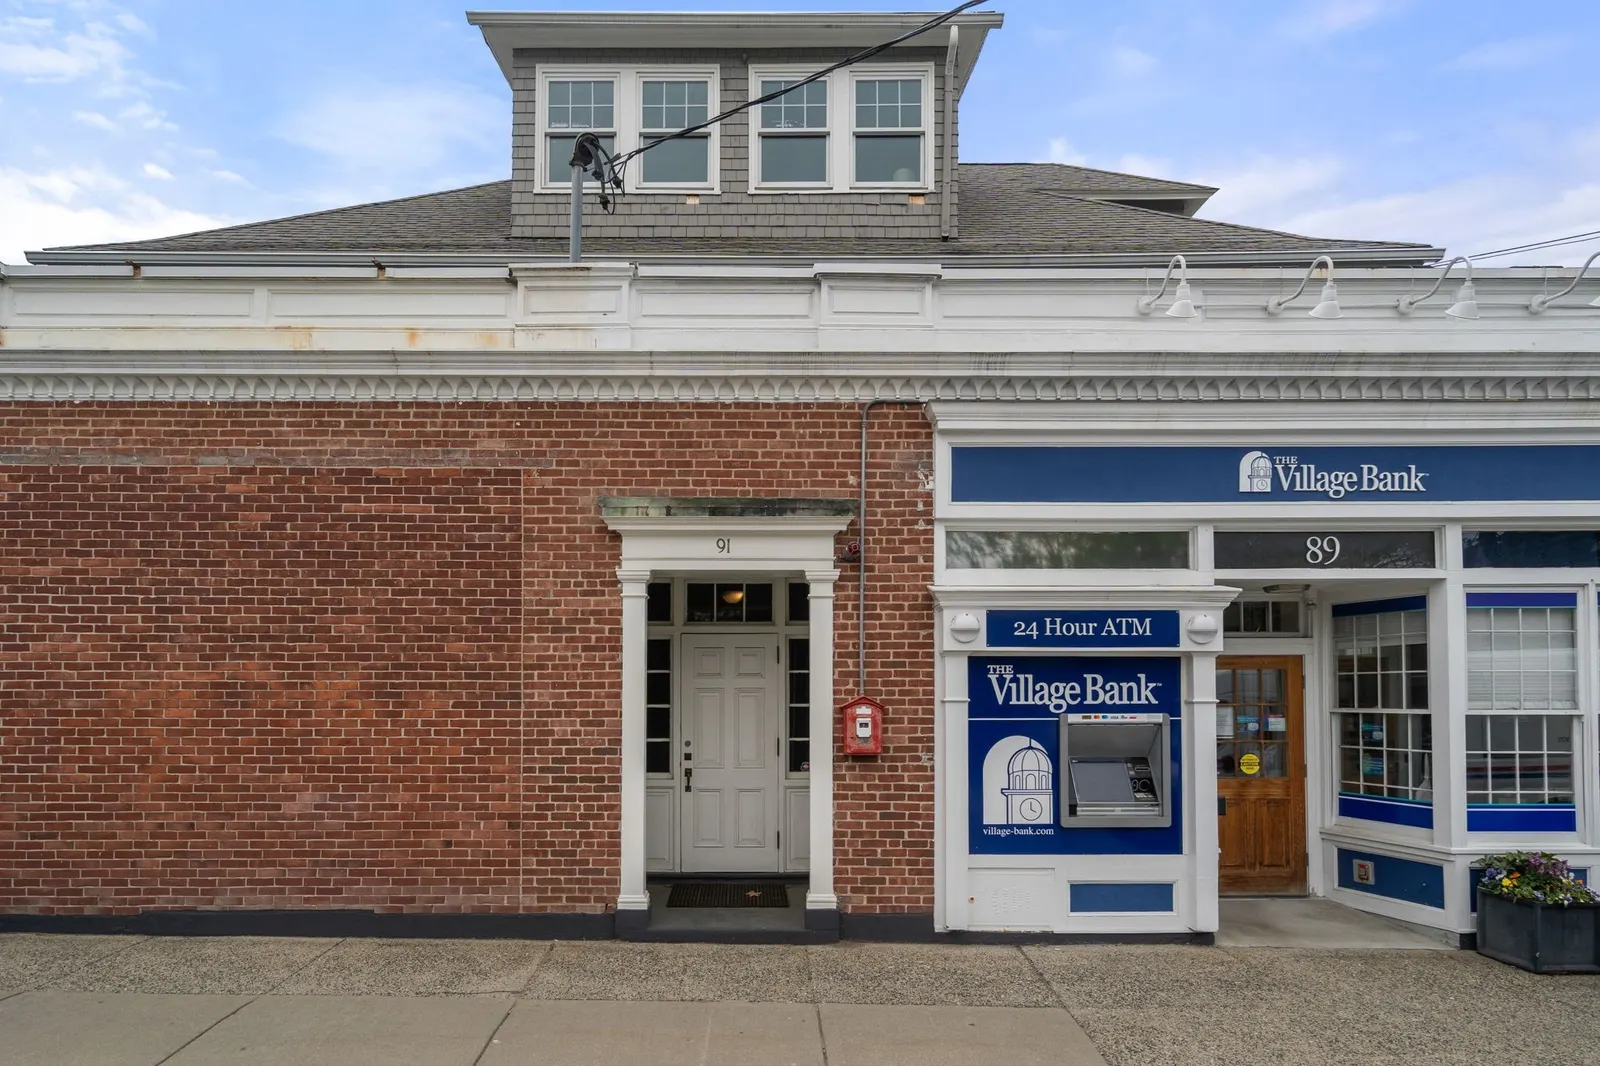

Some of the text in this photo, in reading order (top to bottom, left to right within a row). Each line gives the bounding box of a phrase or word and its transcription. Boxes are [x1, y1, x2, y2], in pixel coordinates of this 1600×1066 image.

[1274, 456, 1298, 464] THE
[1274, 464, 1426, 499] Village Bank
[716, 538, 731, 554] 91
[1305, 536, 1341, 566] 89
[1013, 618, 1152, 640] 24 Hour ATM
[987, 665, 1014, 674] THE
[987, 673, 1159, 714] Village Bank
[982, 826, 1055, 838] village-bank.com
